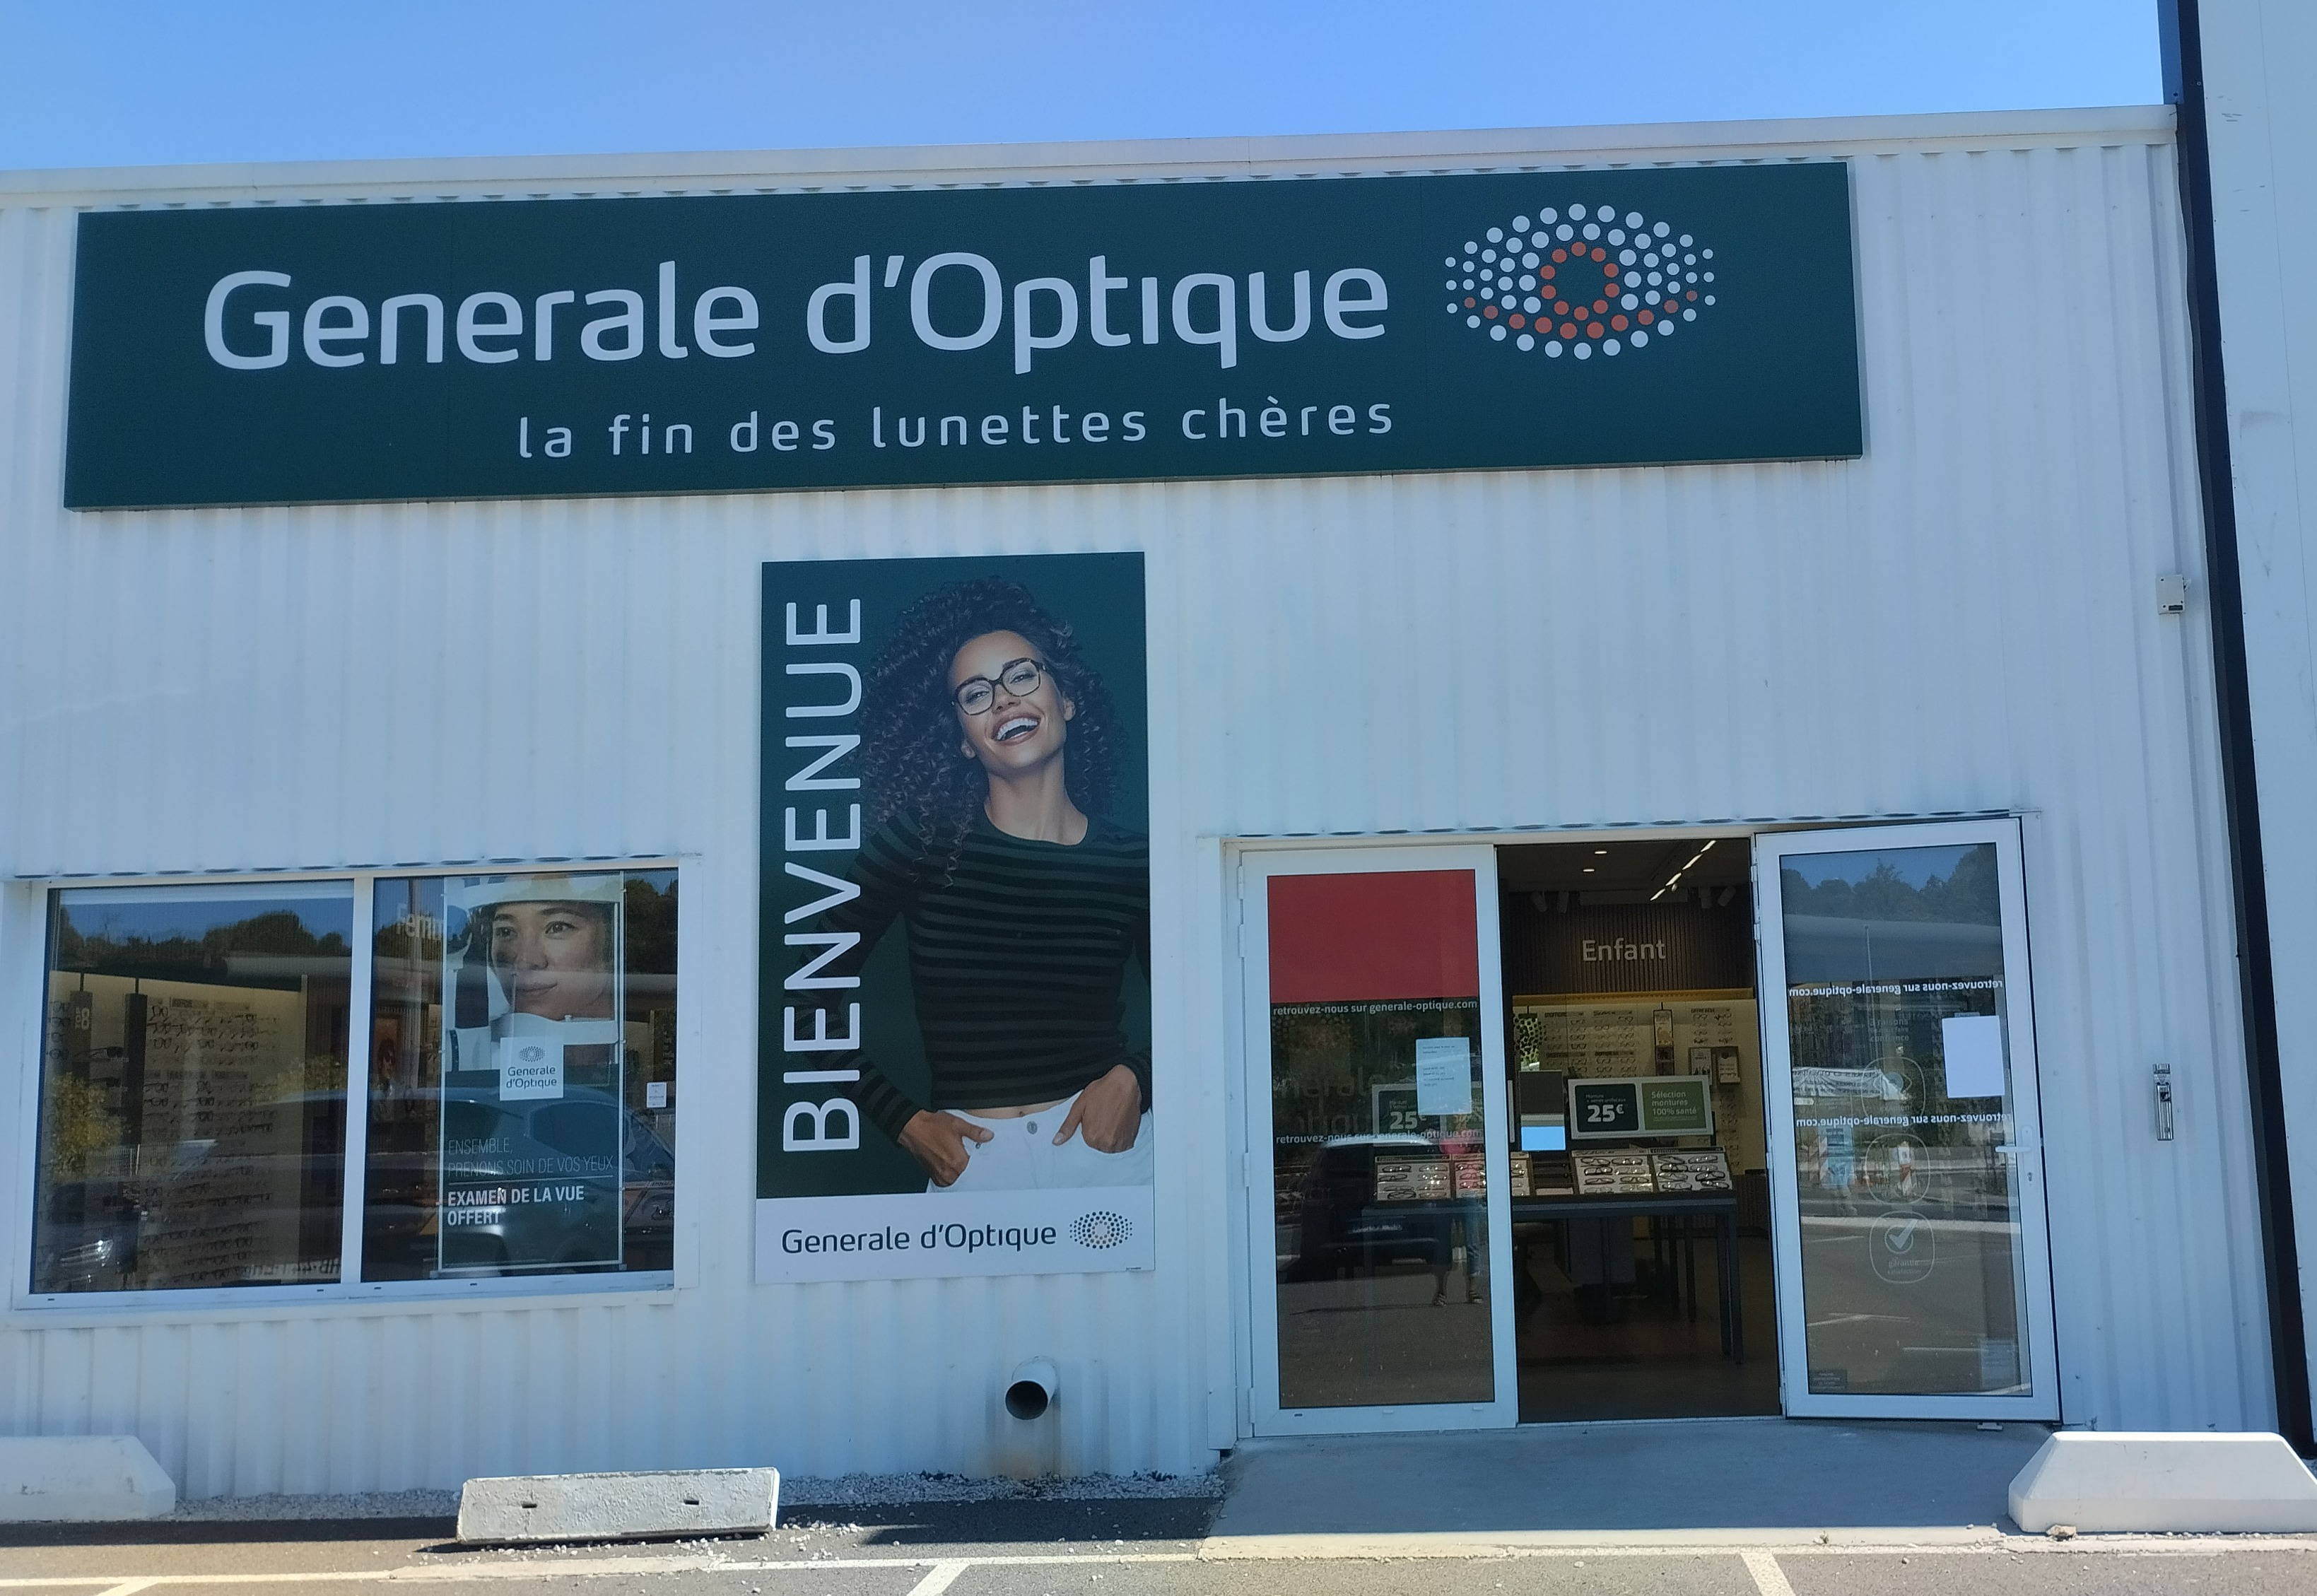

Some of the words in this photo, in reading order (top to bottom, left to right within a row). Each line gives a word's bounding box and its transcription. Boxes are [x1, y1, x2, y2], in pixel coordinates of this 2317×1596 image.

[204, 259, 760, 370] Generale
[806, 251, 1389, 375] d'Optique
[519, 416, 573, 459] la
[608, 413, 693, 456] fin
[729, 410, 837, 452] des
[872, 404, 1147, 449] lunettes
[1181, 395, 1392, 441] chères
[782, 598, 863, 1154] BIENVENUE
[1582, 937, 1666, 962] Enfant
[1273, 1004, 1349, 1015] retrouvez-nous
[1351, 1004, 1367, 1013] sur
[1369, 1000, 1477, 1014] generale-optique.com
[507, 1065, 556, 1077] Generale
[505, 1078, 558, 1090] d'Optique
[1651, 1091, 1687, 1099] Sélection
[1651, 1099, 1689, 1108] montures
[1587, 1103, 1625, 1122] 25€
[1652, 1107, 1674, 1116] 100%
[1676, 1105, 1697, 1115] santé
[1372, 1129, 1482, 1142] enerale-optique.com
[448, 1137, 513, 1155] ENSEMBLE,
[506, 1158, 534, 1176] SOIN
[538, 1157, 554, 1174] DE
[557, 1156, 581, 1173] VOS
[582, 1154, 614, 1171] YEUX
[447, 1188, 507, 1207] EXAMEN
[511, 1187, 530, 1204] DE
[534, 1186, 552, 1202] LA
[555, 1185, 585, 1202] VUE
[447, 1209, 500, 1226] OFFERT
[781, 1225, 910, 1254] Generale
[920, 1223, 1057, 1254] d'Optique
